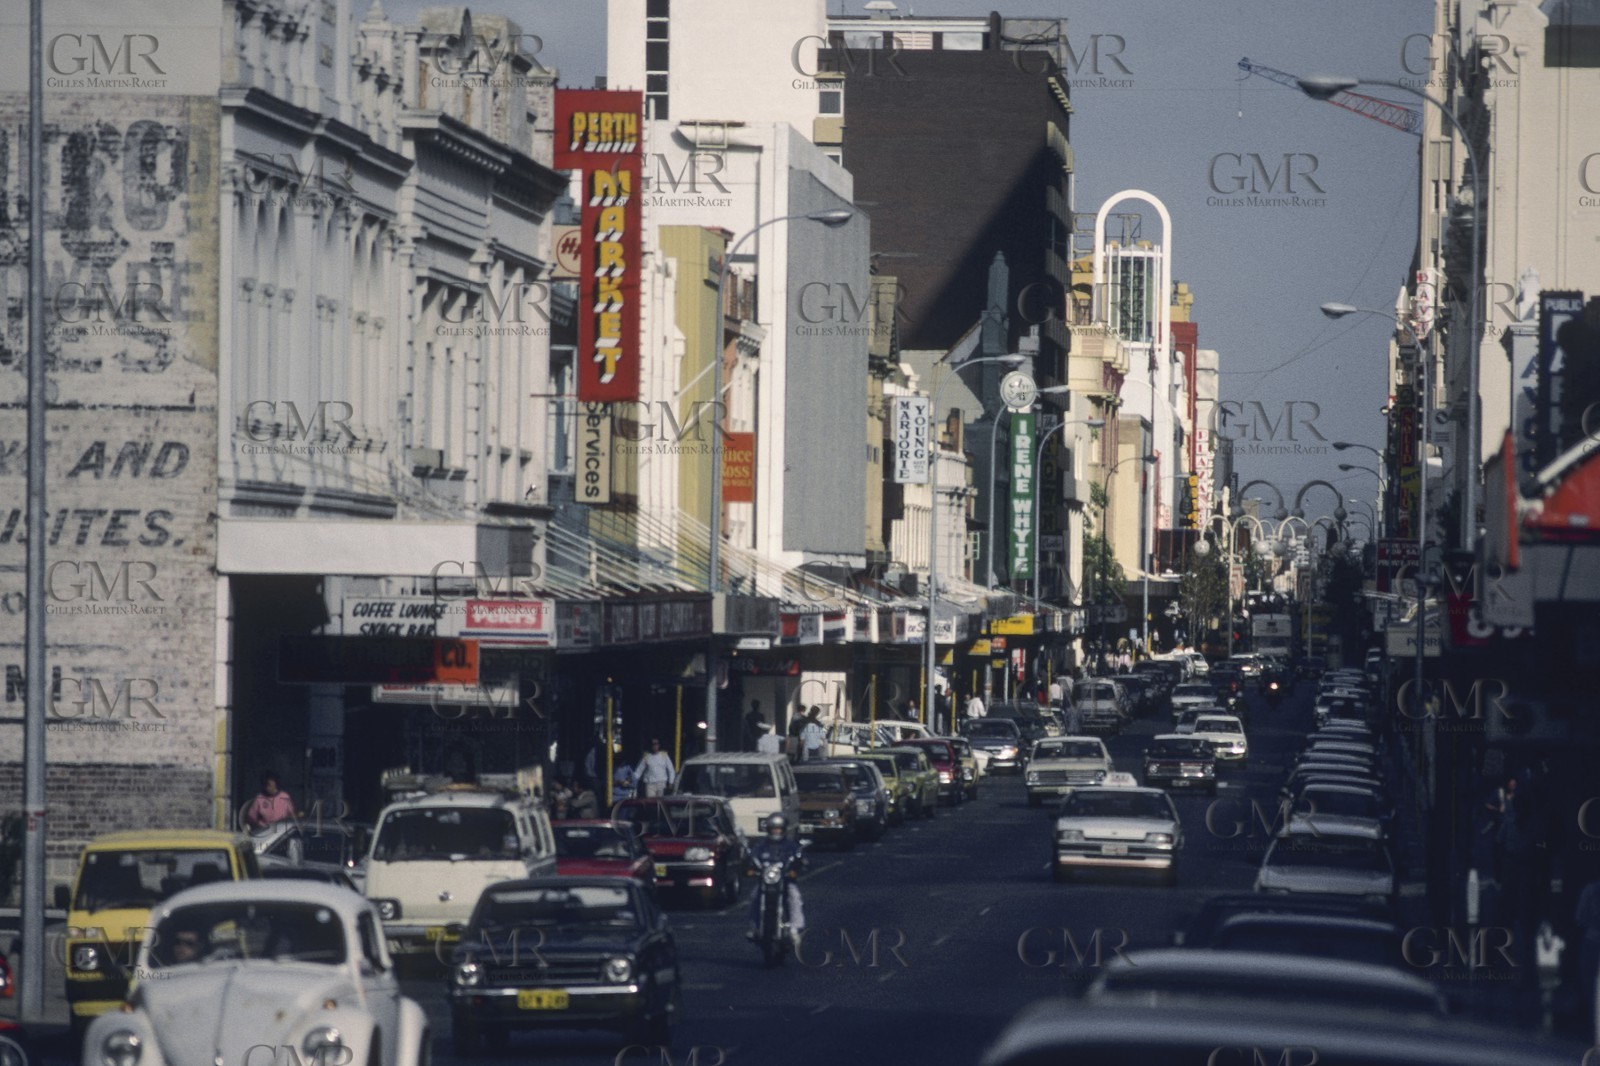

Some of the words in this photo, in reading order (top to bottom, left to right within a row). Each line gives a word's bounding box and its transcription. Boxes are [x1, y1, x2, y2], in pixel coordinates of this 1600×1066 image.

[571, 112, 637, 151] PERTH
[590, 169, 632, 384] MARKET
[1544, 299, 1582, 312] PUBLIC
[66, 440, 189, 480] AND
[584, 401, 608, 499] Services
[898, 400, 910, 478] MARJORIE
[914, 405, 926, 459] YOUNG
[1014, 419, 1031, 493] IRENE
[1012, 499, 1032, 572] WHYTE
[352, 602, 395, 617] COFFEE
[359, 623, 403, 637] SNACK
